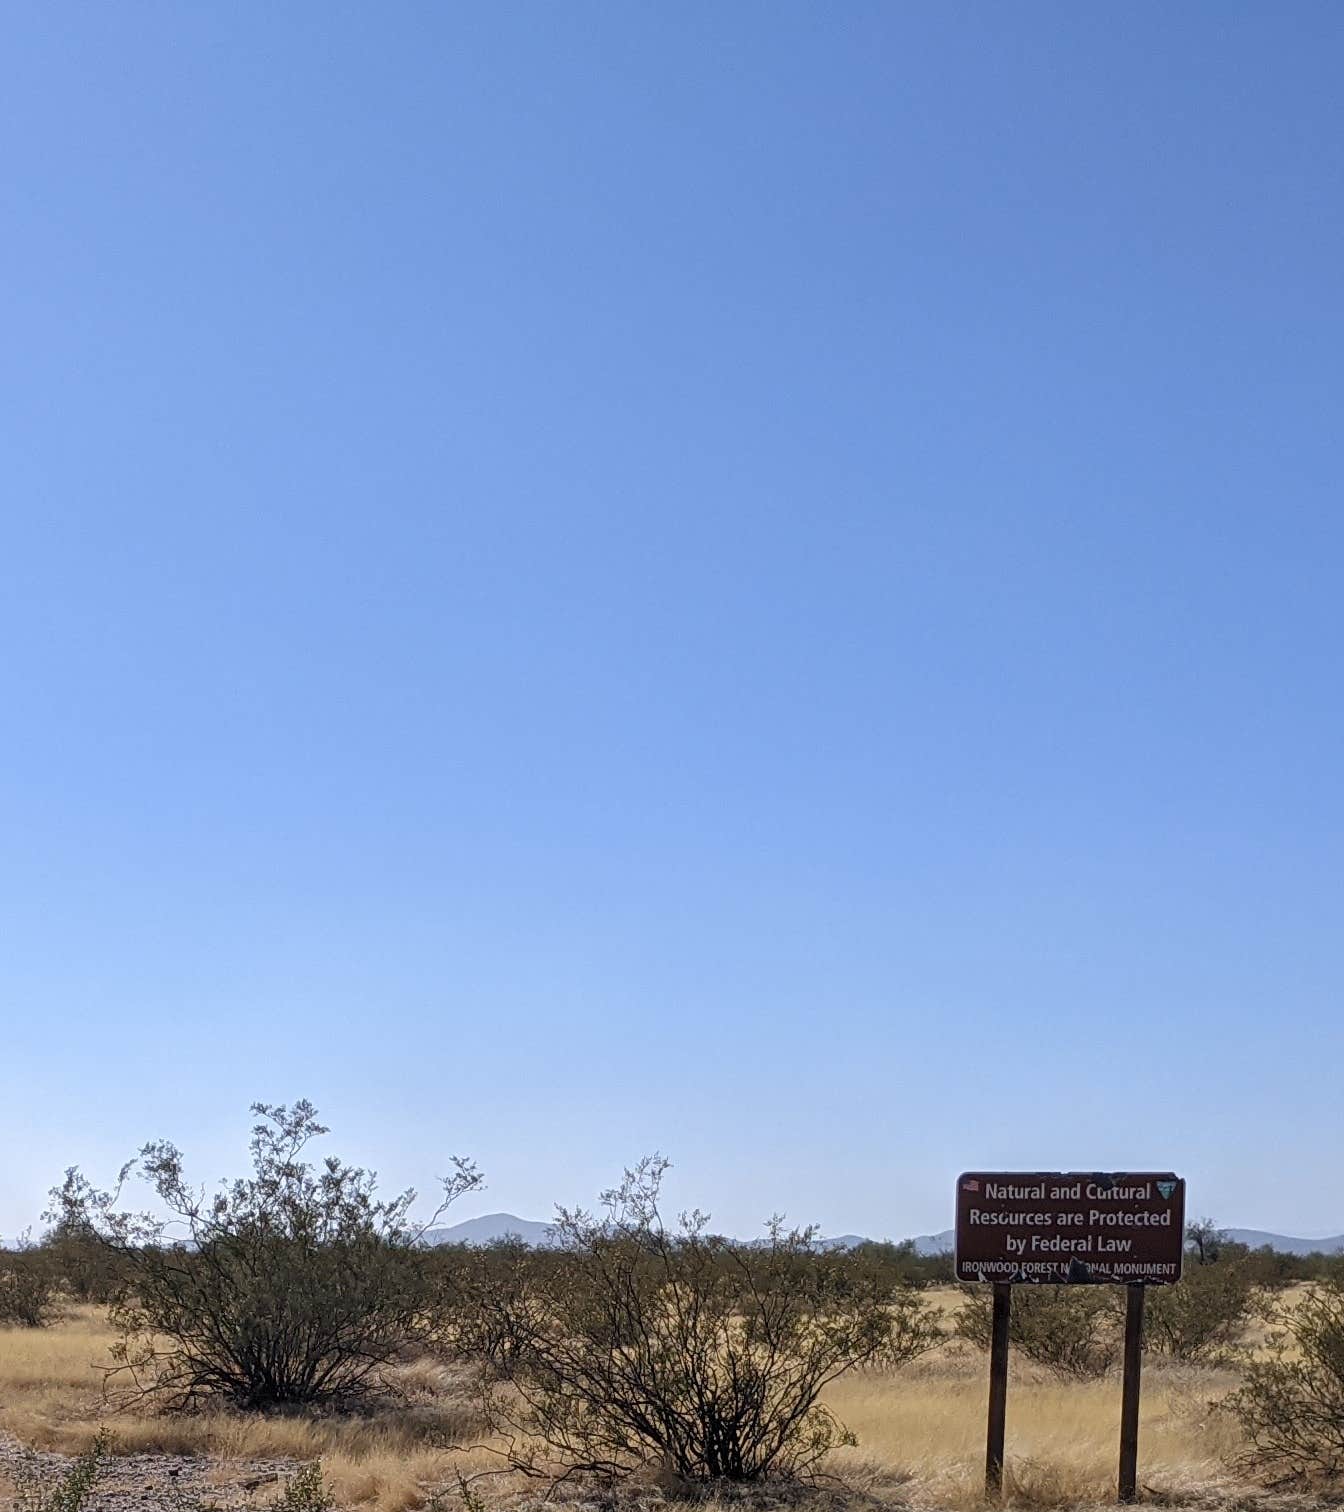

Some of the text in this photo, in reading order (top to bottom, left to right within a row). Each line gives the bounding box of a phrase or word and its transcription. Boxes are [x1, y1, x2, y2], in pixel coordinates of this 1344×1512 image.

[985, 1183, 1045, 1200] Natural
[1050, 1183, 1080, 1200] and
[969, 1209, 1171, 1226] Resources are Protected
[1006, 1235, 1131, 1255] by Federal Law
[962, 1261, 1019, 1273] IRONWOOD
[1021, 1262, 1058, 1274] FOREST
[1114, 1263, 1176, 1275] MONUMENT
